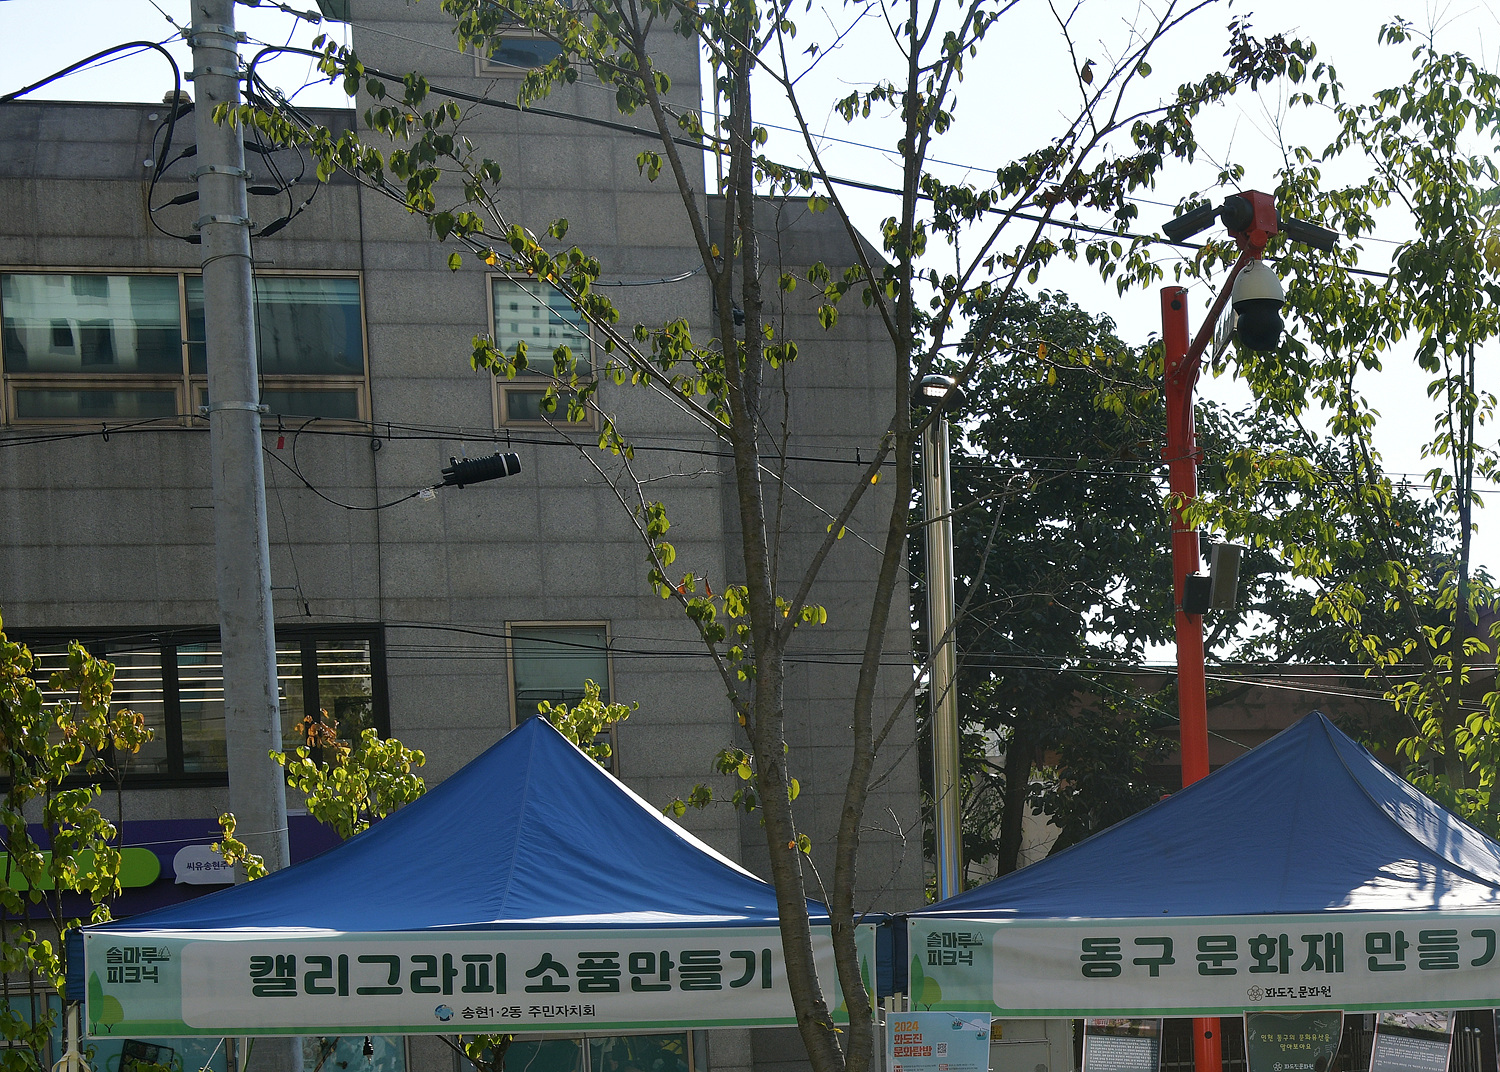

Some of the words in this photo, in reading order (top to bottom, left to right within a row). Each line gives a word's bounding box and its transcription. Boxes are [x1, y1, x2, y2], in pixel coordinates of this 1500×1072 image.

[927, 931, 983, 949] 솔마루
[106, 945, 170, 964] 솔마루
[927, 949, 973, 967] 피크닉
[1080, 936, 1176, 978] 동구
[1196, 931, 1345, 976] 문화재
[106, 966, 159, 984] 피크닉
[249, 952, 507, 998] 캘리그라피
[524, 948, 772, 994] 소품만들기
[1264, 985, 1332, 999] 화도진문화원
[461, 1004, 523, 1020] 송현1·2동
[528, 1003, 596, 1018] 주민자치회
[894, 1021, 919, 1033] 2024
[893, 1033, 923, 1045] 화도진
[893, 1045, 933, 1058] 문화탐방
